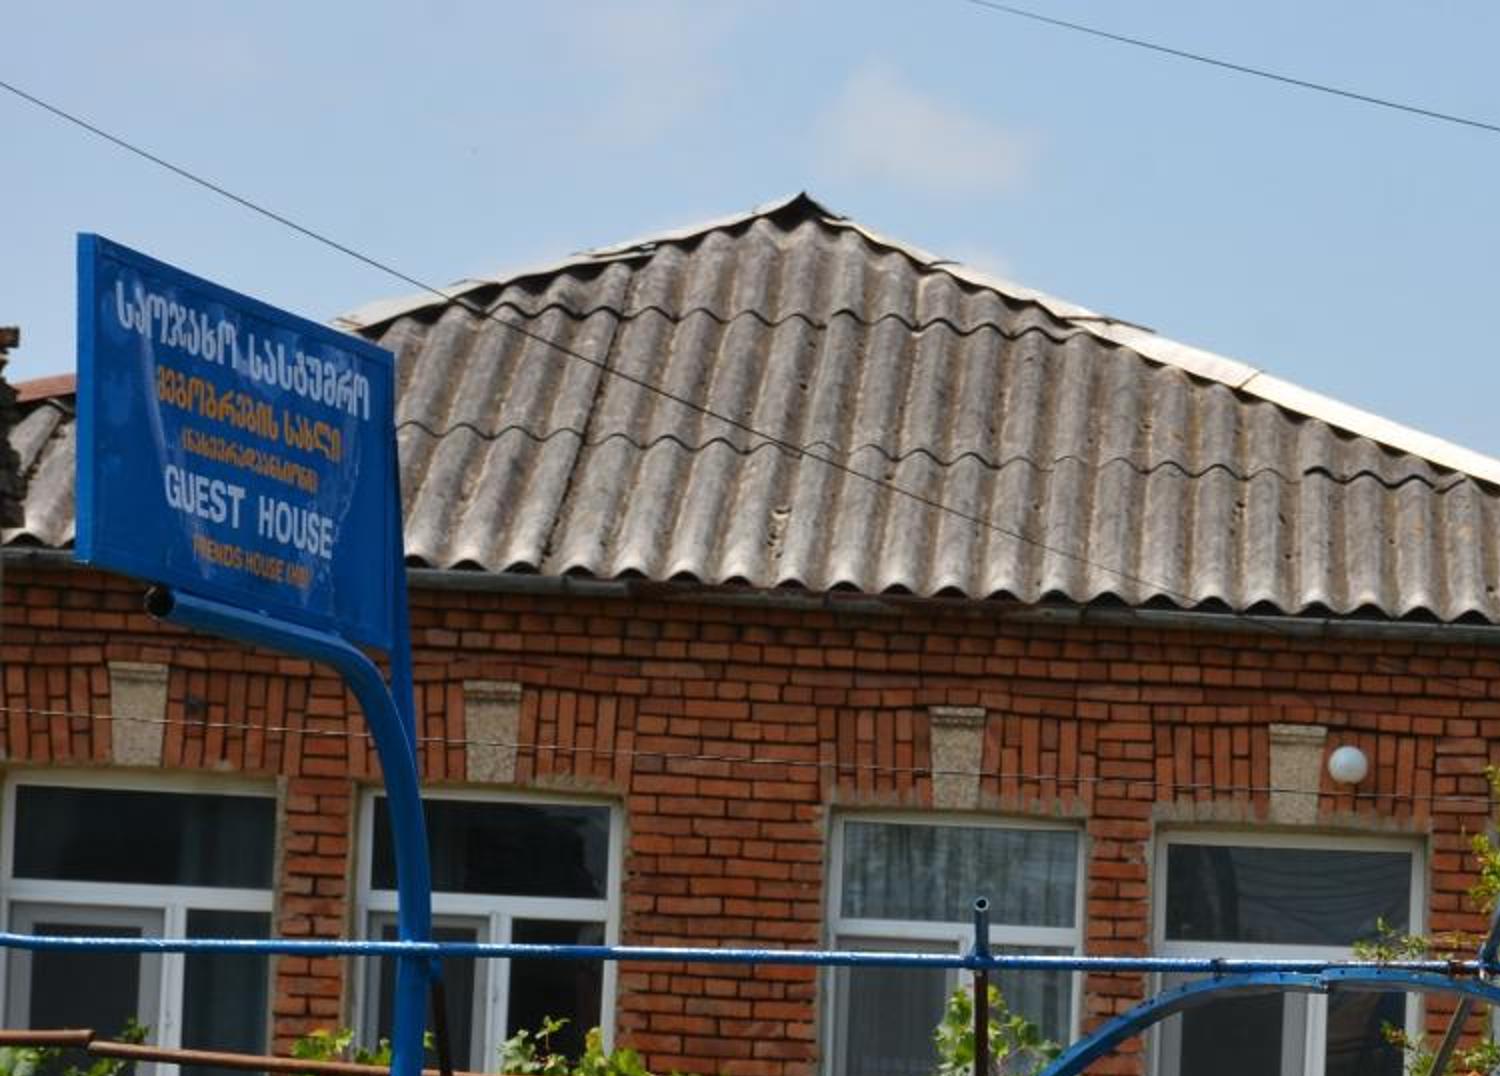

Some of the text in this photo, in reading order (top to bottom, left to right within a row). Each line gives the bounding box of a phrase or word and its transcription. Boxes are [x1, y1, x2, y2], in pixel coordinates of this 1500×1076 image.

[115, 280, 369, 420] საოჯახო სასტუმრო
[284, 409, 342, 465] სახლი
[165, 464, 333, 560] GUEST HOUSE
